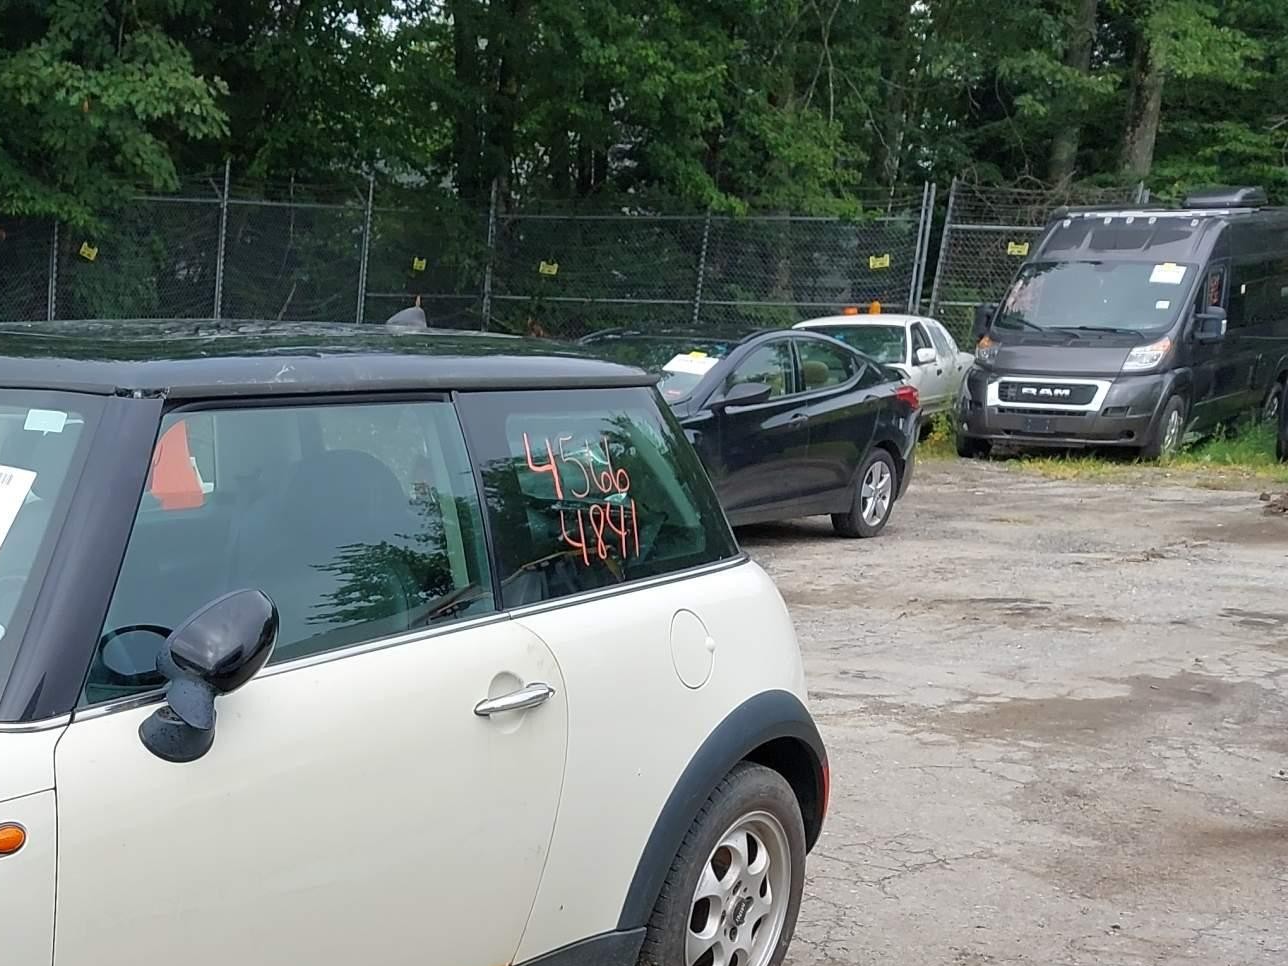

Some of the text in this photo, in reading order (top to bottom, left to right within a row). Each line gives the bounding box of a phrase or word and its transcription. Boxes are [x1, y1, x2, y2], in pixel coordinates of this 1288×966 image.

[1022, 387, 1071, 396] RAM
[523, 432, 630, 500] 4566
[560, 498, 640, 566] 4841
